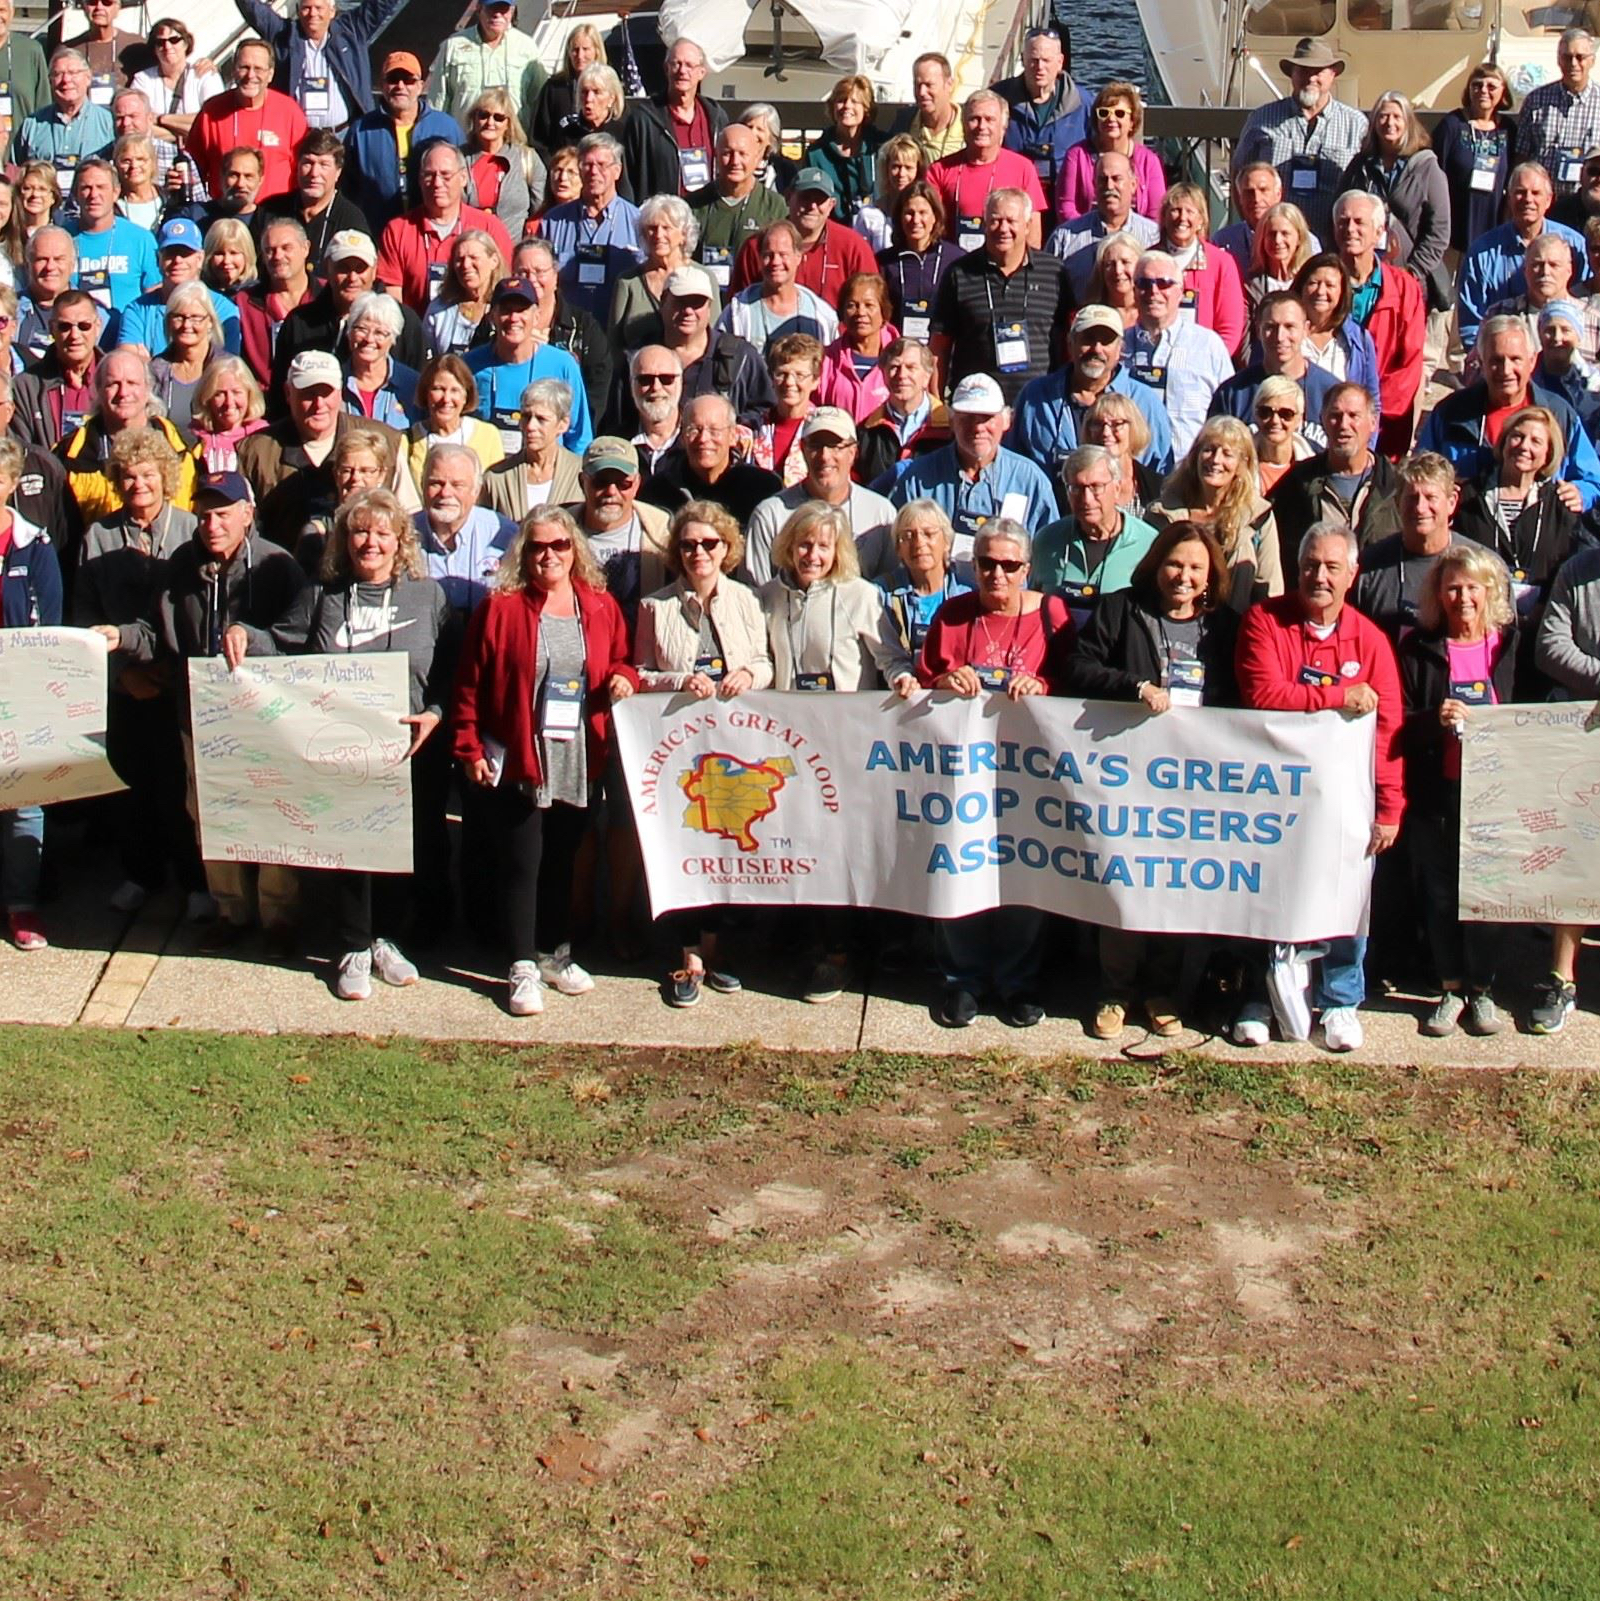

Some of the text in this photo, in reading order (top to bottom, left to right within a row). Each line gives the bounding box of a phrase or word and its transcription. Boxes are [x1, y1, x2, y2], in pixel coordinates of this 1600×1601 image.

[350, 606, 398, 630] NIKE
[9, 631, 61, 649] Marina
[284, 660, 314, 685] Joe
[322, 660, 375, 684] Marina
[640, 710, 840, 816] AMERICA'S GREAT LOOP
[865, 740, 1312, 796] AMERICA'S GREAT
[896, 788, 1299, 846] LOOP CRUISERS'
[682, 857, 817, 875] CRUISERS'
[926, 834, 1262, 893] ASSOCIATION
[707, 876, 790, 885] ASSOCIATION
